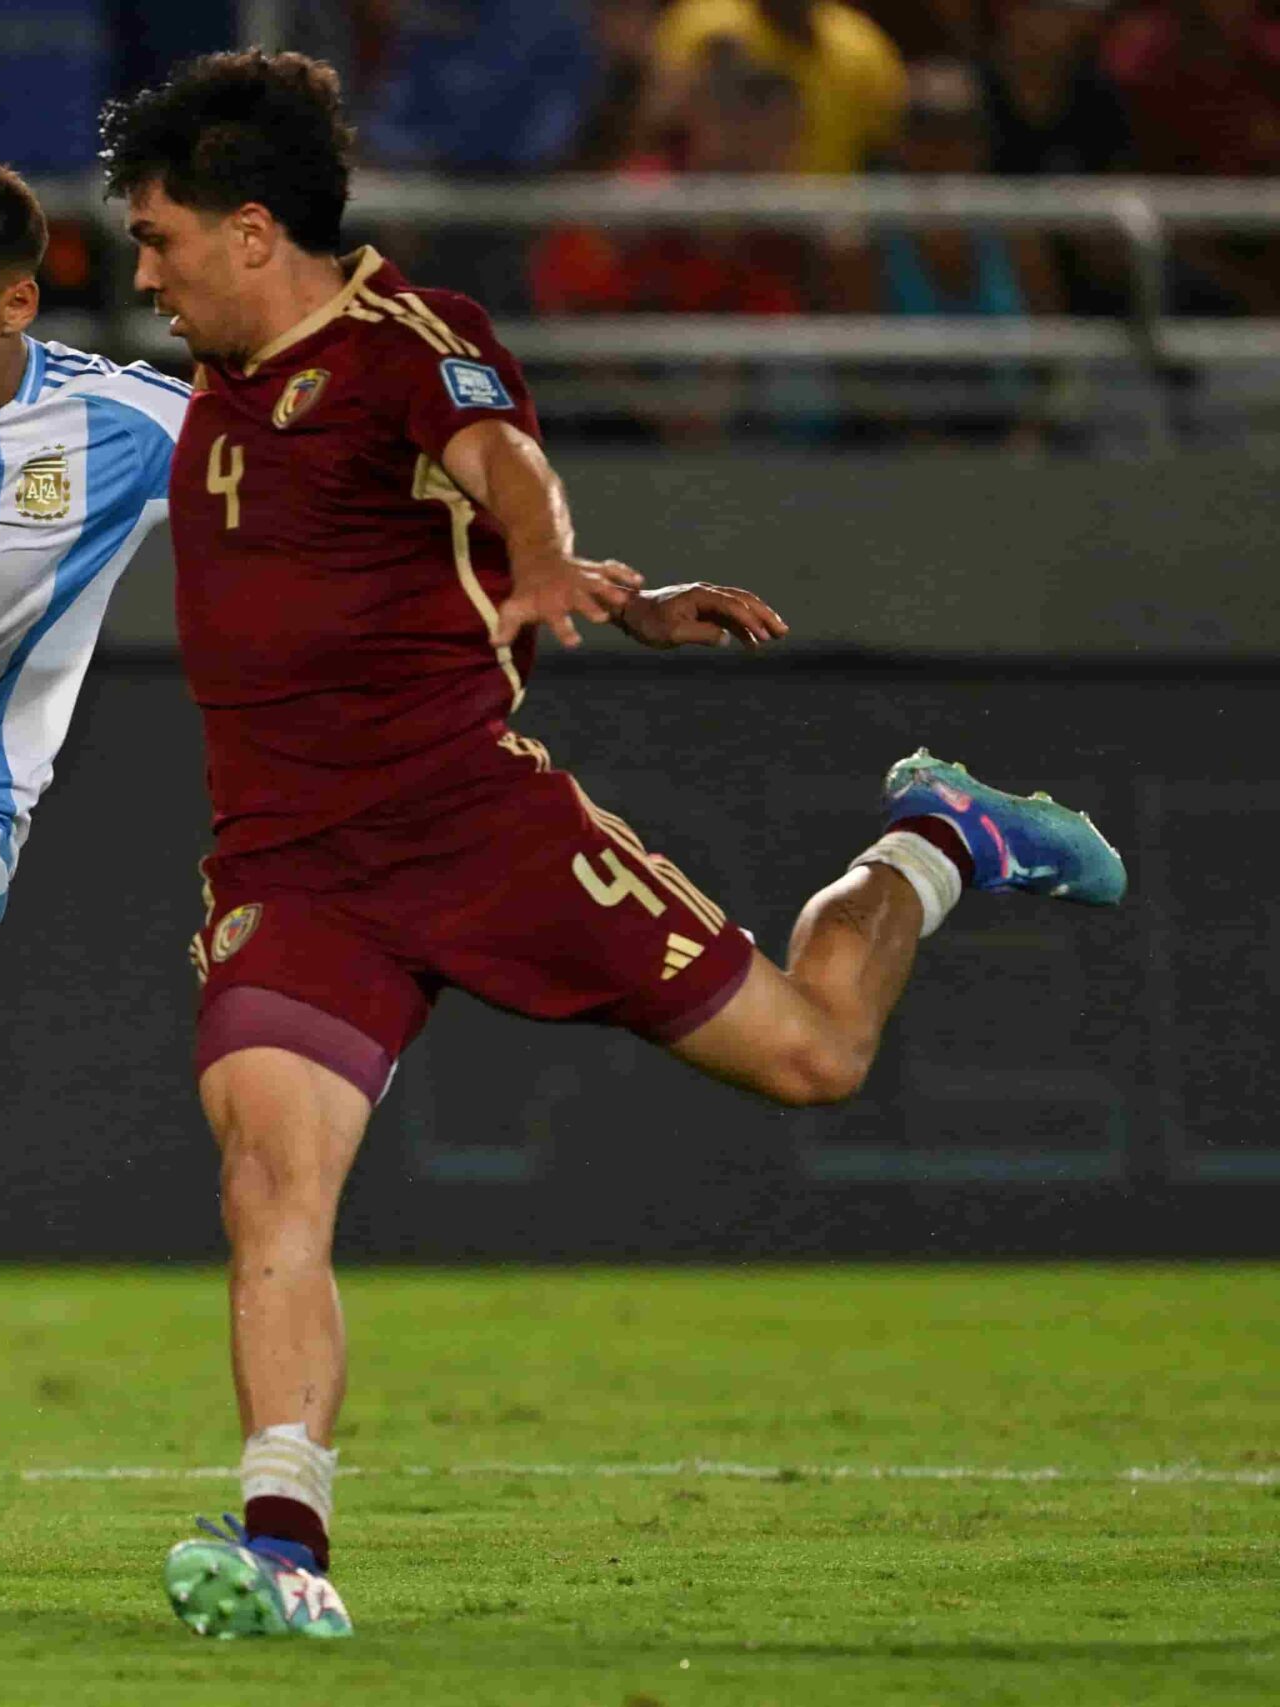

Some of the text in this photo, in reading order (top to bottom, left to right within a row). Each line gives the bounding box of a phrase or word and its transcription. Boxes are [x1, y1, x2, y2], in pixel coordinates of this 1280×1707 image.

[26, 473, 60, 505] AFA
[206, 432, 245, 529] 4
[572, 848, 668, 918] 4
